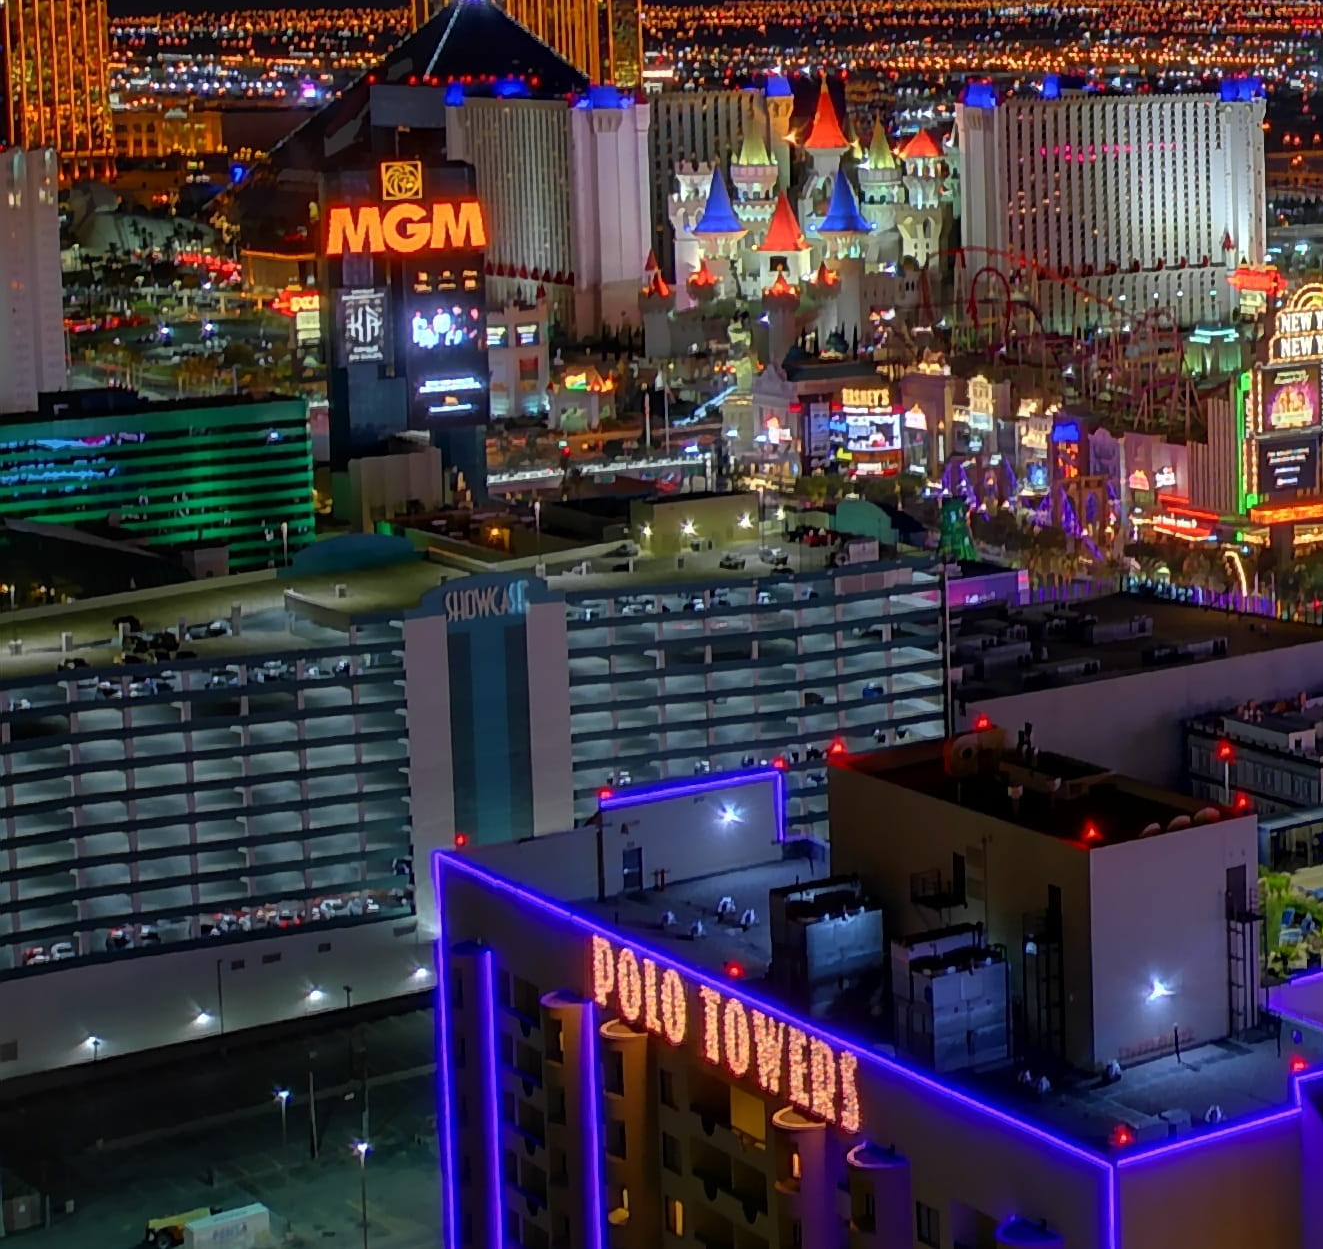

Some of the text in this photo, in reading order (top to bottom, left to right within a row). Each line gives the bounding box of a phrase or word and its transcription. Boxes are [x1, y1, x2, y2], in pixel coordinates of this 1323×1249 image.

[326, 202, 487, 255] MGM
[1280, 310, 1313, 334] NEW
[1280, 334, 1314, 359] NEW
[592, 934, 862, 1134] POLO TOWERS
